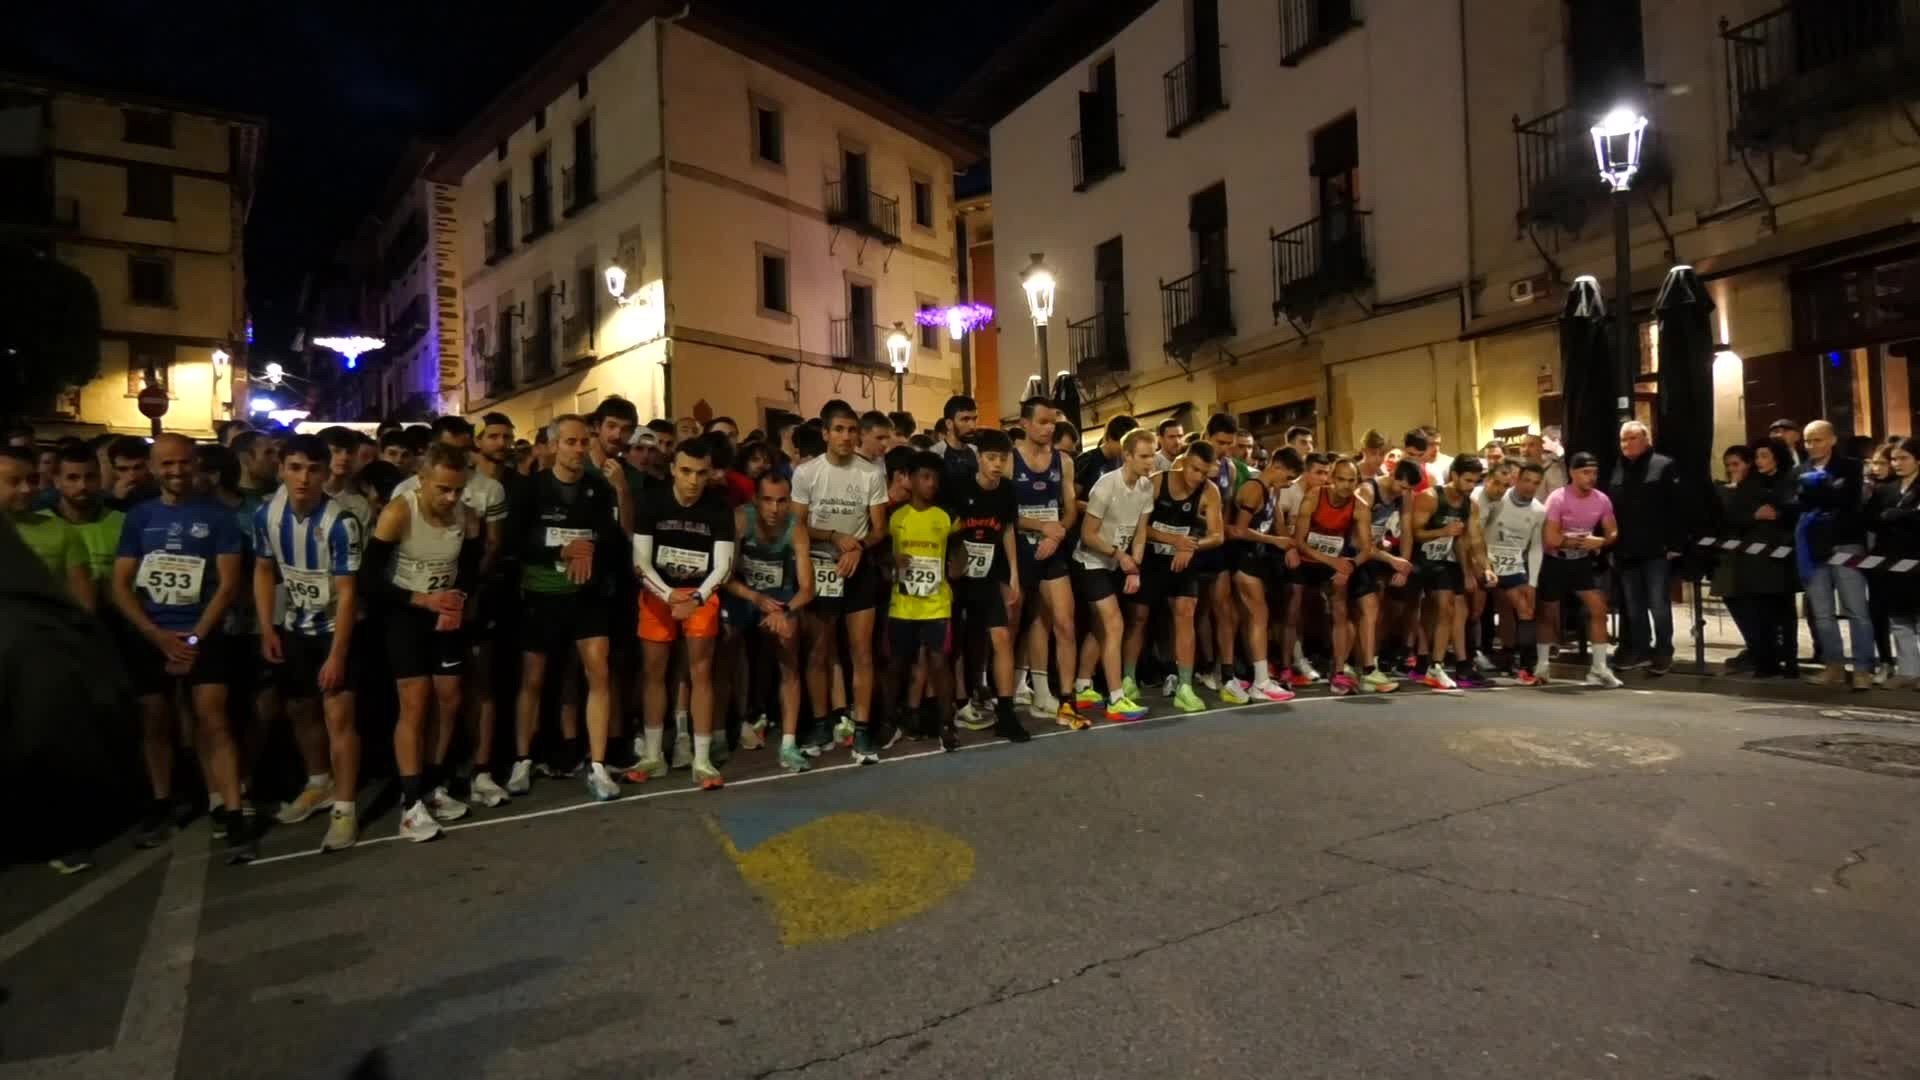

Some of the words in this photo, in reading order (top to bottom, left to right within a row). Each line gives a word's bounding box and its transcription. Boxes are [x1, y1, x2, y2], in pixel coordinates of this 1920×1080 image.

[148, 571, 192, 589] 533
[428, 575, 450, 590] 22
[817, 570, 837, 583] 50
[905, 570, 936, 583] 529
[287, 579, 320, 599] 369
